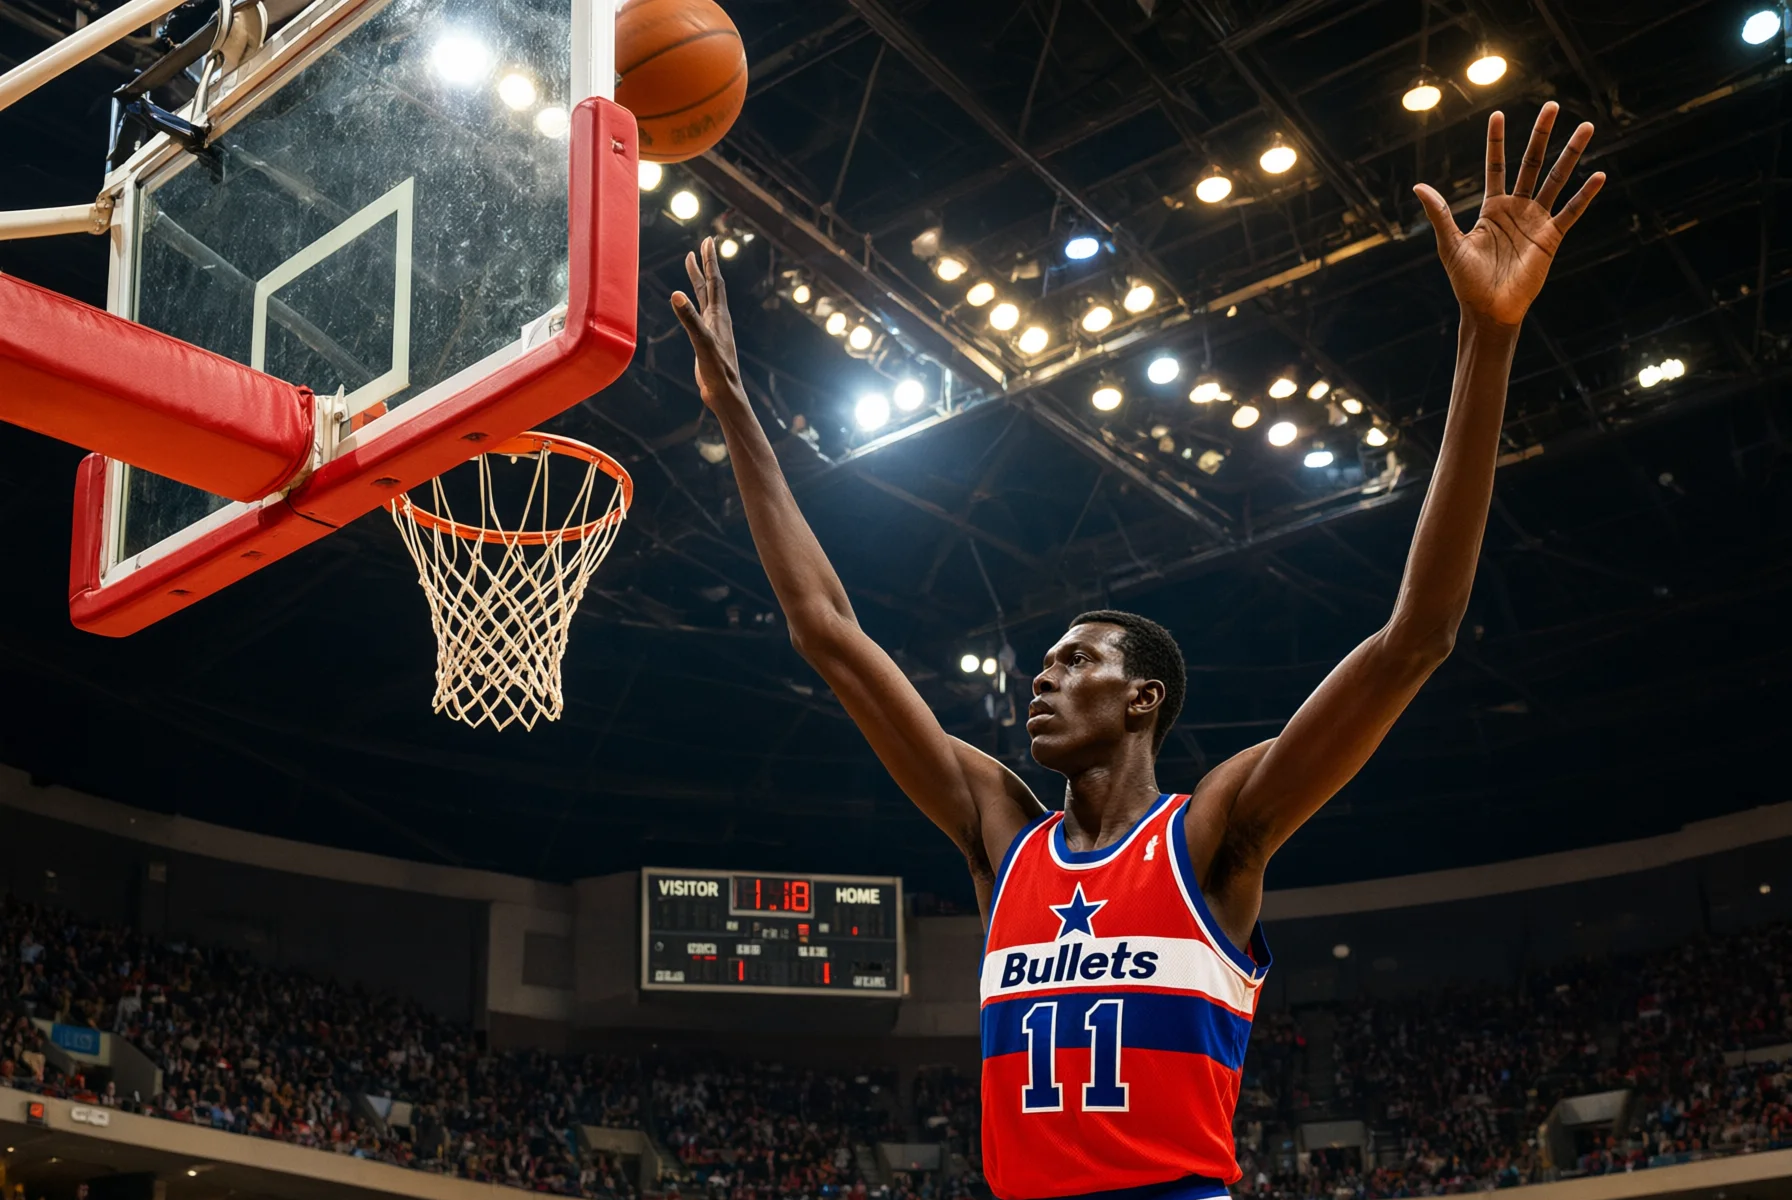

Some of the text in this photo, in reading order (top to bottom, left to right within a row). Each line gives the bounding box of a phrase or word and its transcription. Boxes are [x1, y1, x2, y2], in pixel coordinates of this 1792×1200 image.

[658, 880, 719, 897] VISITOR
[835, 887, 881, 905] HOME
[1000, 942, 1159, 989] Bullets
[1021, 998, 1130, 1114] 11
